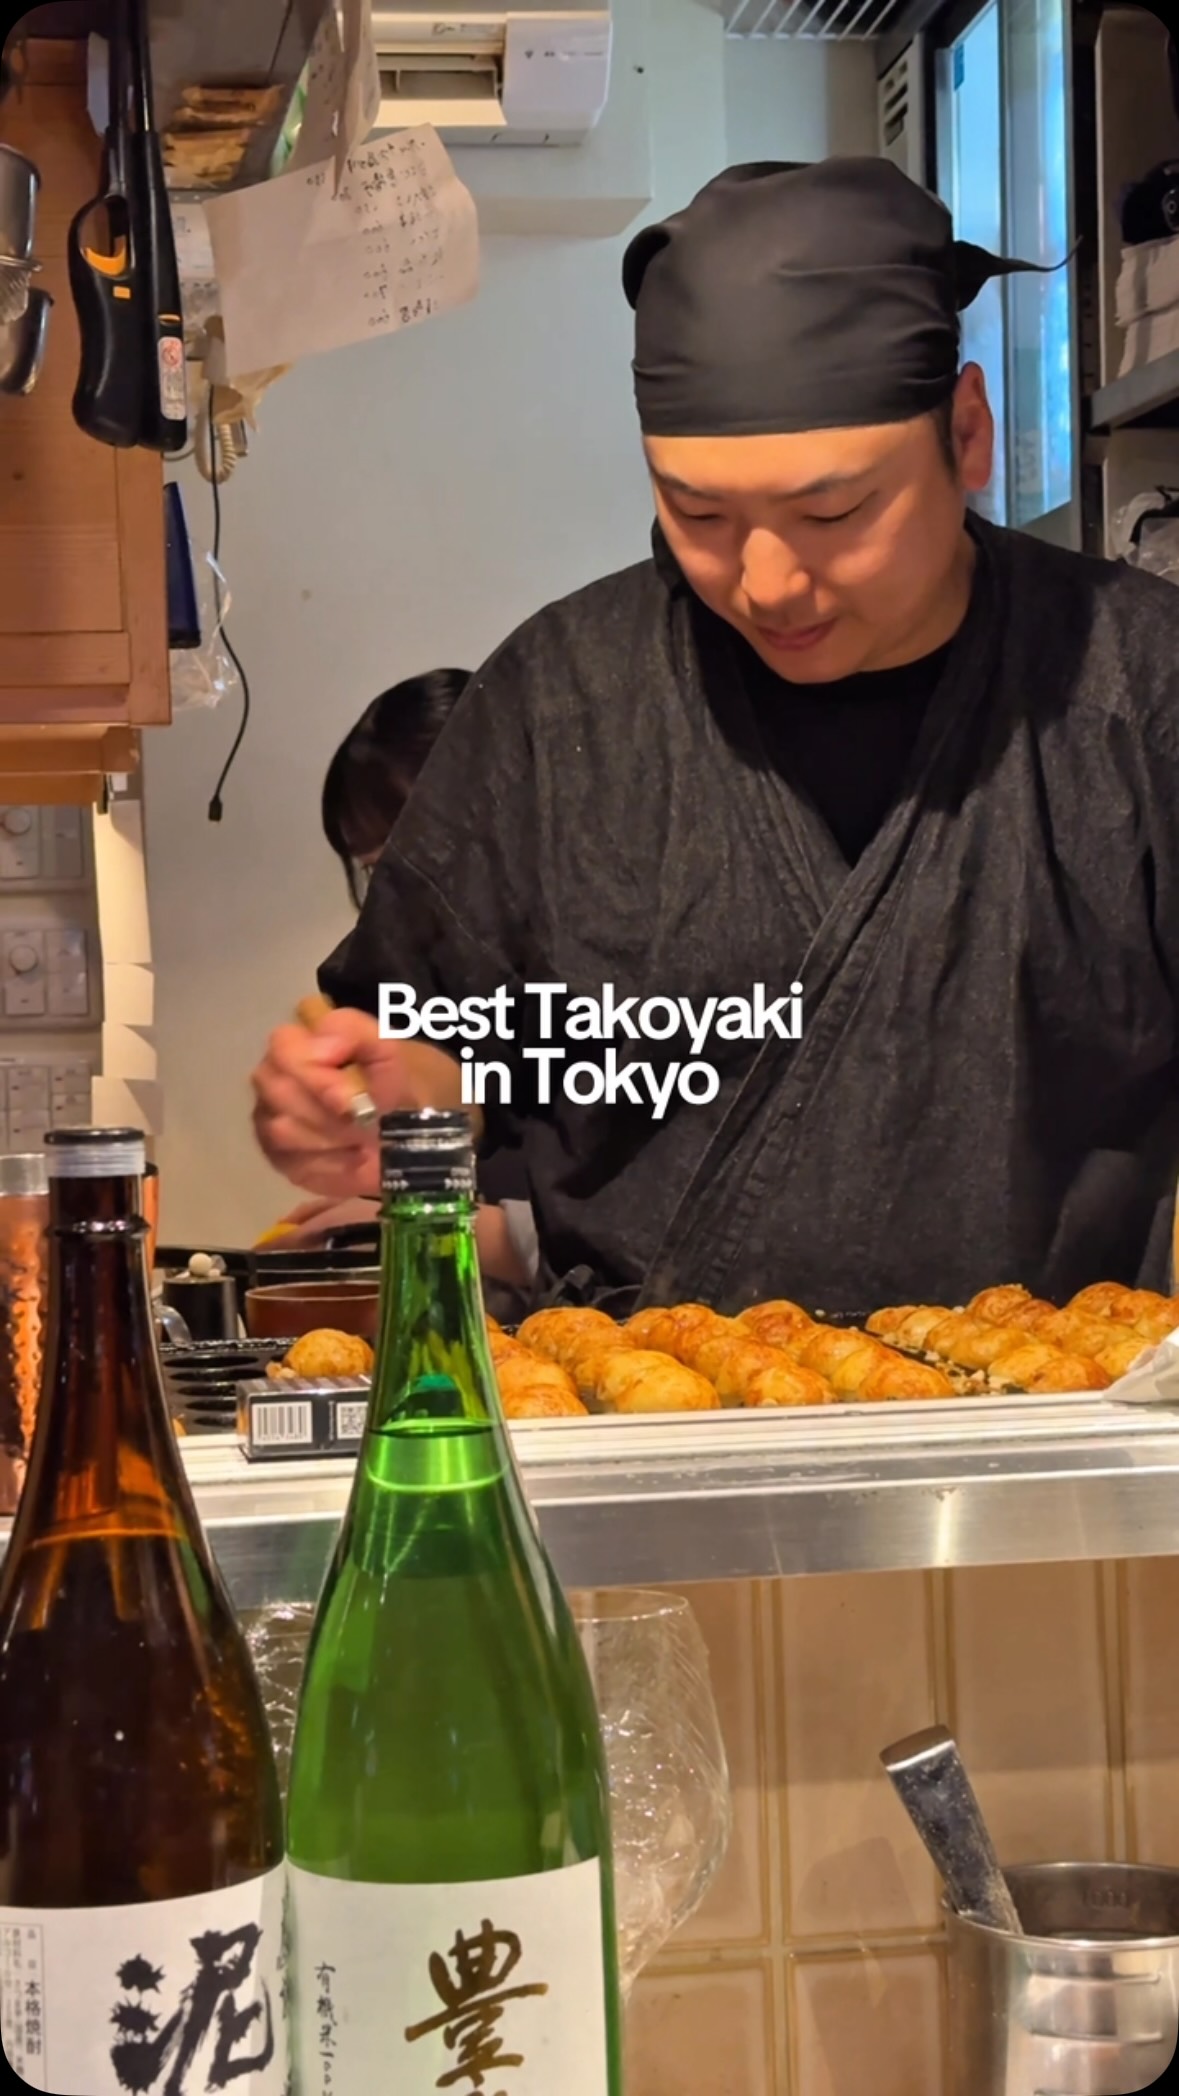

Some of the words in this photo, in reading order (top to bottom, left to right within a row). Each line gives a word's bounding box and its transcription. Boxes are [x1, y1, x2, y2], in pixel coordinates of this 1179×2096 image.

[25, 1980, 42, 2056] 本格焼酎
[110, 1923, 274, 2096] 泥
[403, 1918, 549, 2096] 豊
